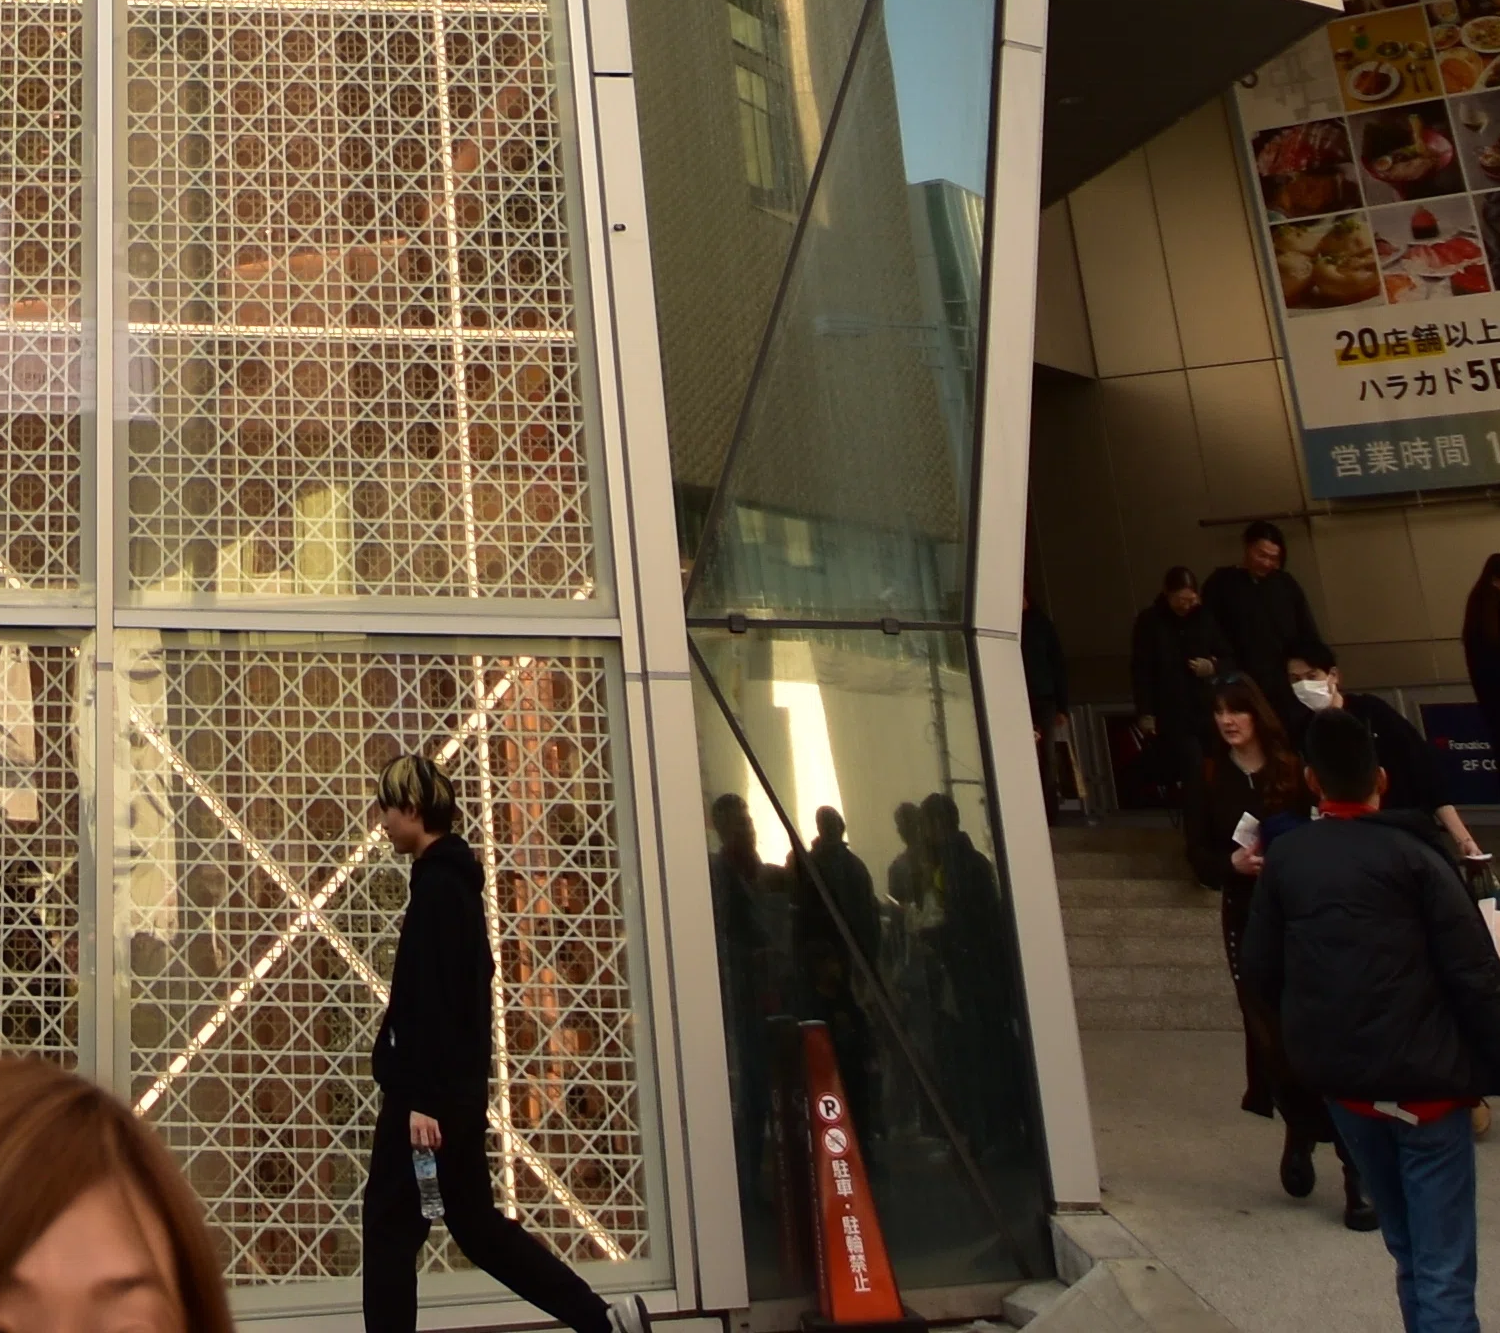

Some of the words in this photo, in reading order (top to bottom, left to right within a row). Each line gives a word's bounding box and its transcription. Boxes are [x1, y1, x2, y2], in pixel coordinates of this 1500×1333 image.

[1330, 433, 1470, 479] 営業時間
[1448, 739, 1491, 750] Fanatics
[1462, 759, 1480, 771] 2F
[830, 1159, 871, 1293] 駐車・駐輪禁止
